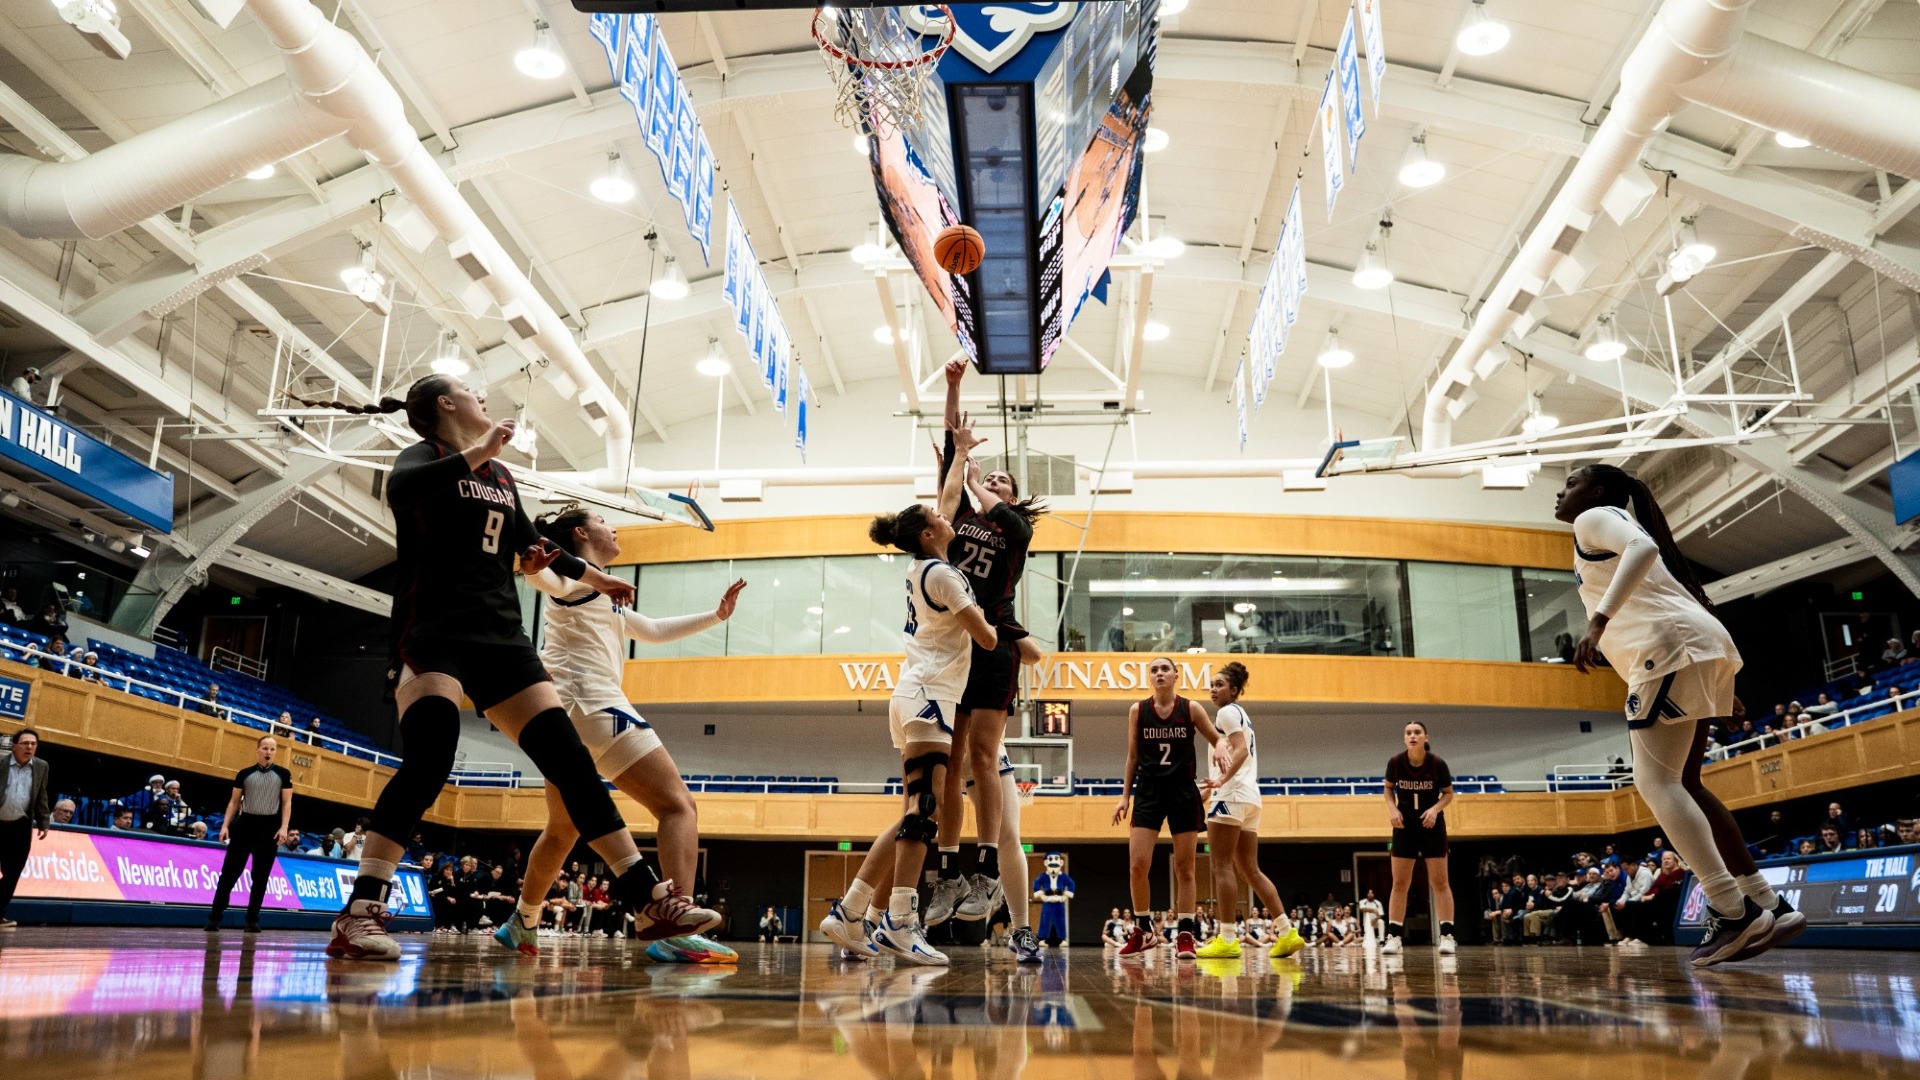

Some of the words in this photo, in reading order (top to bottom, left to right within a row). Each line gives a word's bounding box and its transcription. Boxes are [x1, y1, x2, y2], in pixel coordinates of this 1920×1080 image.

[18, 406, 82, 474] HALL
[458, 479, 516, 511] COUGARS
[482, 509, 505, 555] 9
[957, 523, 1006, 549] COUGARS
[956, 541, 996, 579] 25
[1044, 702, 1069, 715] 3:24
[1047, 714, 1066, 733] 17
[1143, 727, 1187, 739] COUGARS
[1158, 743, 1172, 766] 2
[1398, 779, 1434, 790] COUGARS
[1413, 792, 1419, 810] 1
[116, 856, 182, 889] Newark
[183, 868, 199, 889] or
[1865, 858, 1884, 878] THE
[1884, 856, 1909, 876] HALL
[294, 873, 317, 898] Bus
[318, 875, 338, 899] #31
[1852, 884, 1868, 893] FOULS
[1875, 883, 1899, 912] 20
